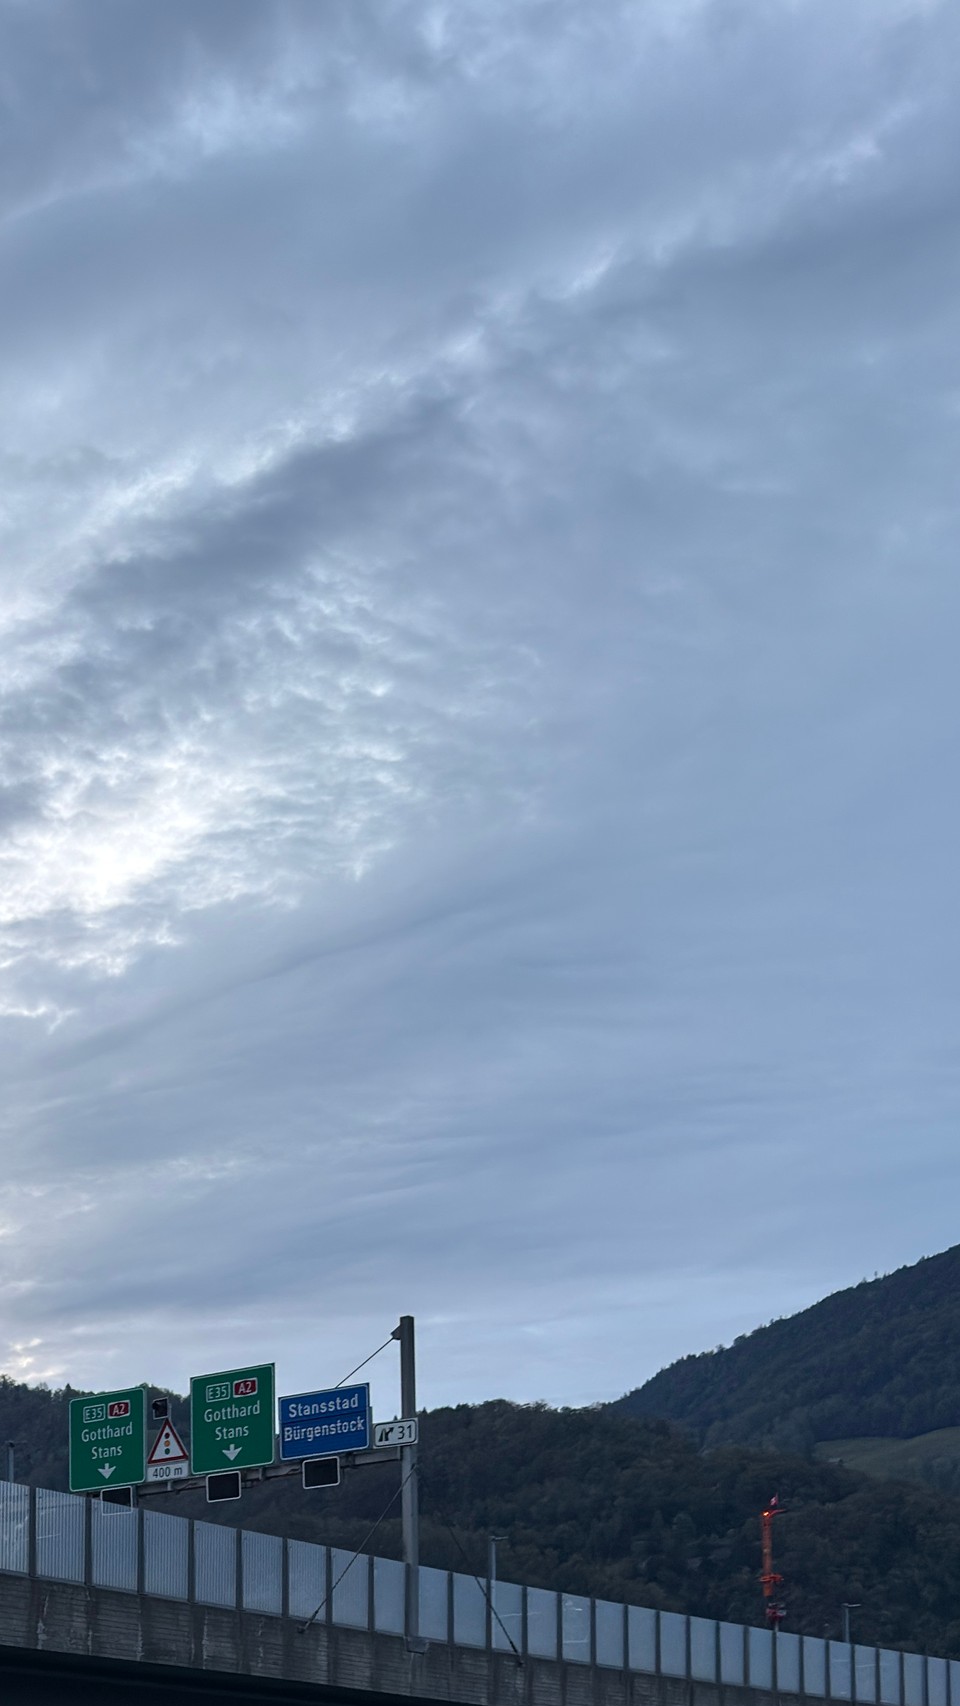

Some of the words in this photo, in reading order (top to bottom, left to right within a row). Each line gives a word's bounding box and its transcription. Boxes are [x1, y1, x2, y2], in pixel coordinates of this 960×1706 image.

[208, 1385, 227, 1400] E35
[238, 1381, 253, 1395] A2
[85, 1407, 103, 1420] E35
[112, 1403, 126, 1416] A2
[204, 1400, 260, 1423] Gotthard
[288, 1393, 360, 1418] Stansstad
[81, 1421, 133, 1443] Gotthard
[215, 1425, 249, 1441] Stans
[284, 1416, 366, 1442] Bürgenstock
[397, 1424, 413, 1440] 31
[91, 1445, 123, 1460] Stans
[152, 1466, 171, 1479] 400
[174, 1467, 183, 1476] m
